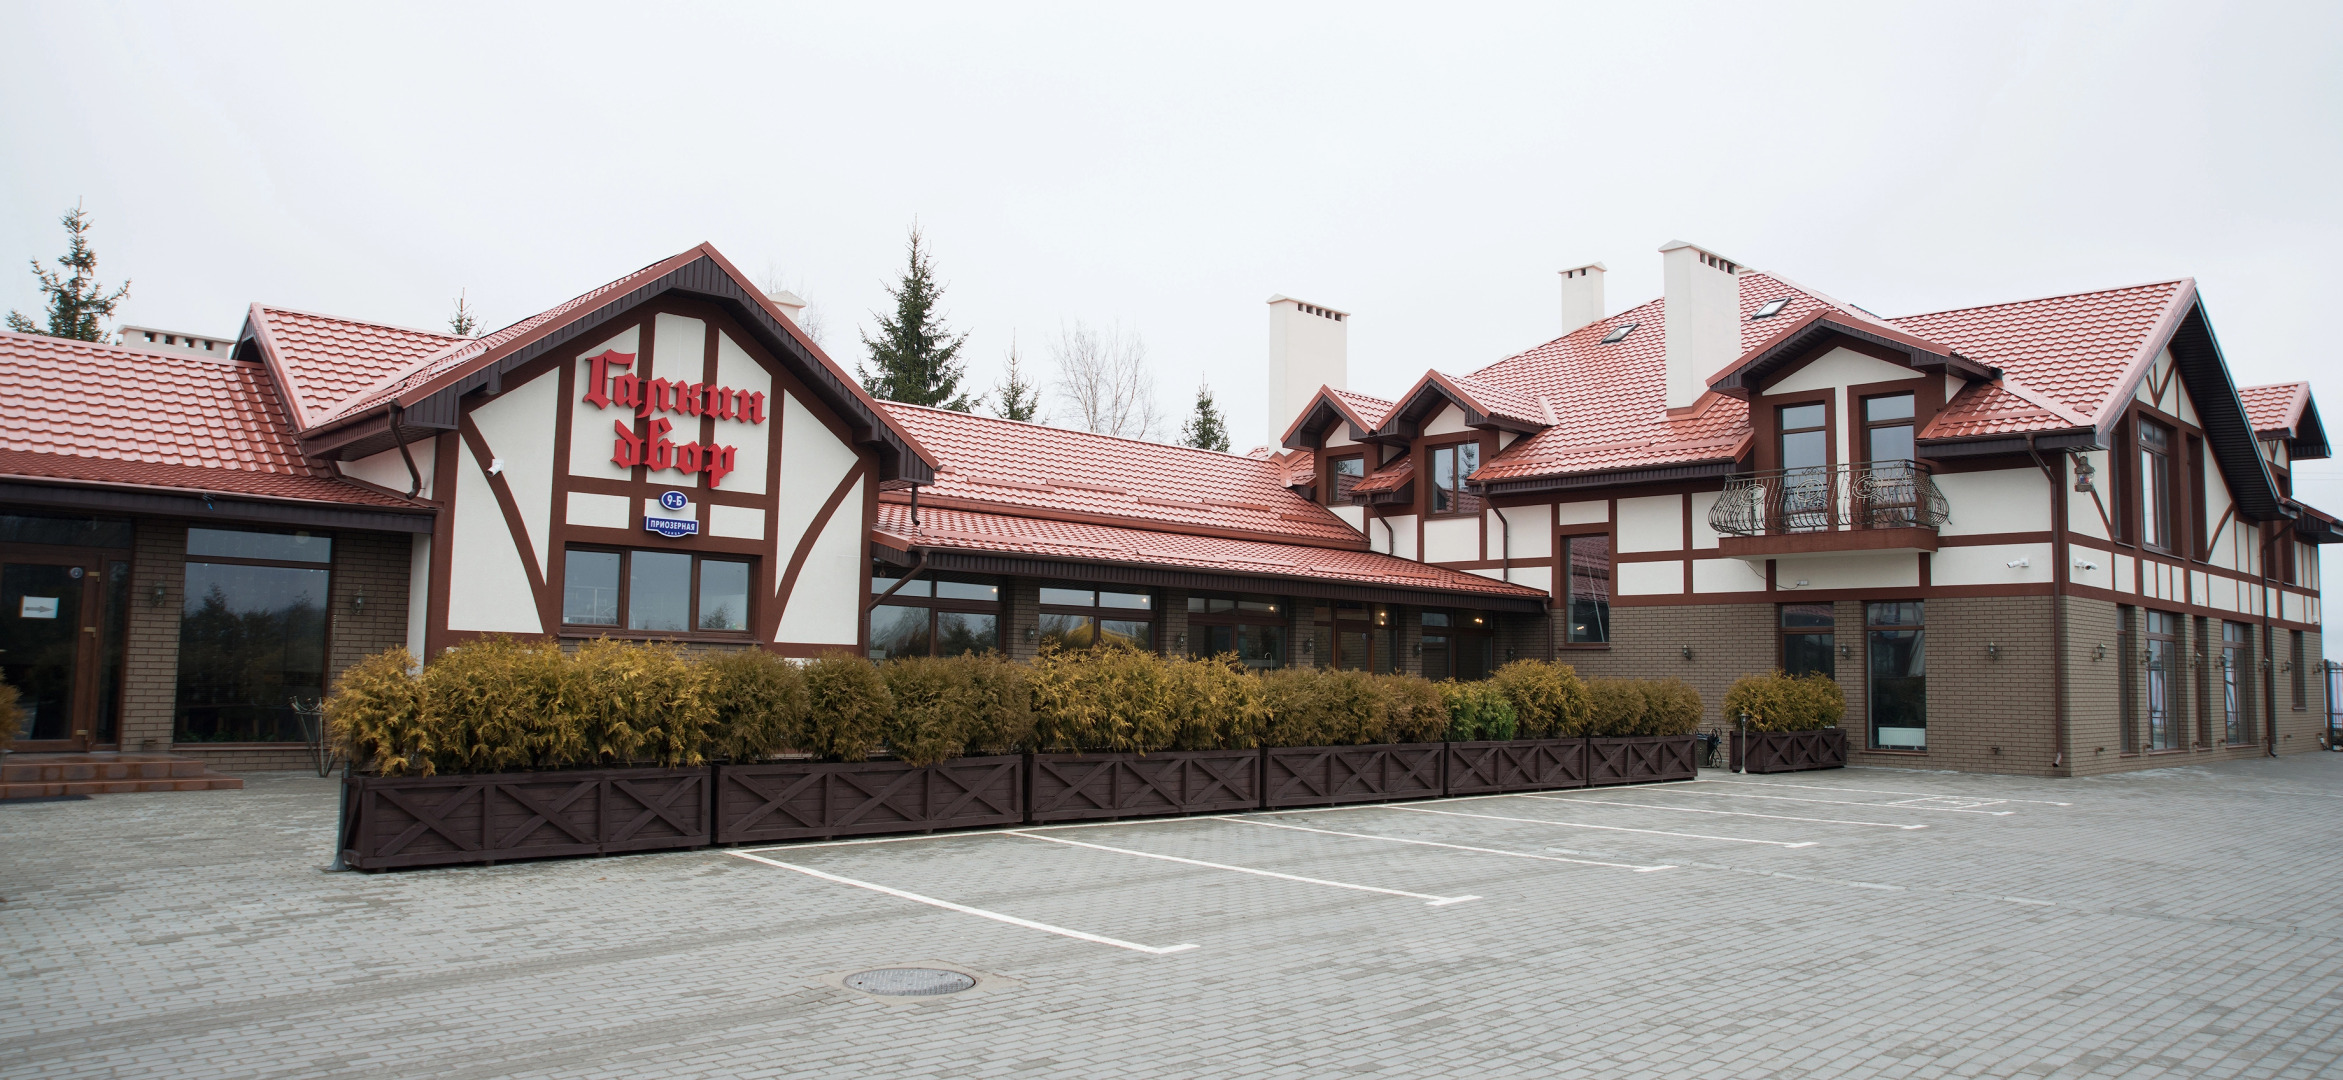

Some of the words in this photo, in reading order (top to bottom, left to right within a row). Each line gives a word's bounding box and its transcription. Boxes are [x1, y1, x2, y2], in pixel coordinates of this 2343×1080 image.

[582, 348, 766, 425] Галкин
[610, 416, 738, 489] двор
[667, 494, 683, 506] 9-Б
[650, 519, 696, 531] ПРИОЗЕРНАЯ
